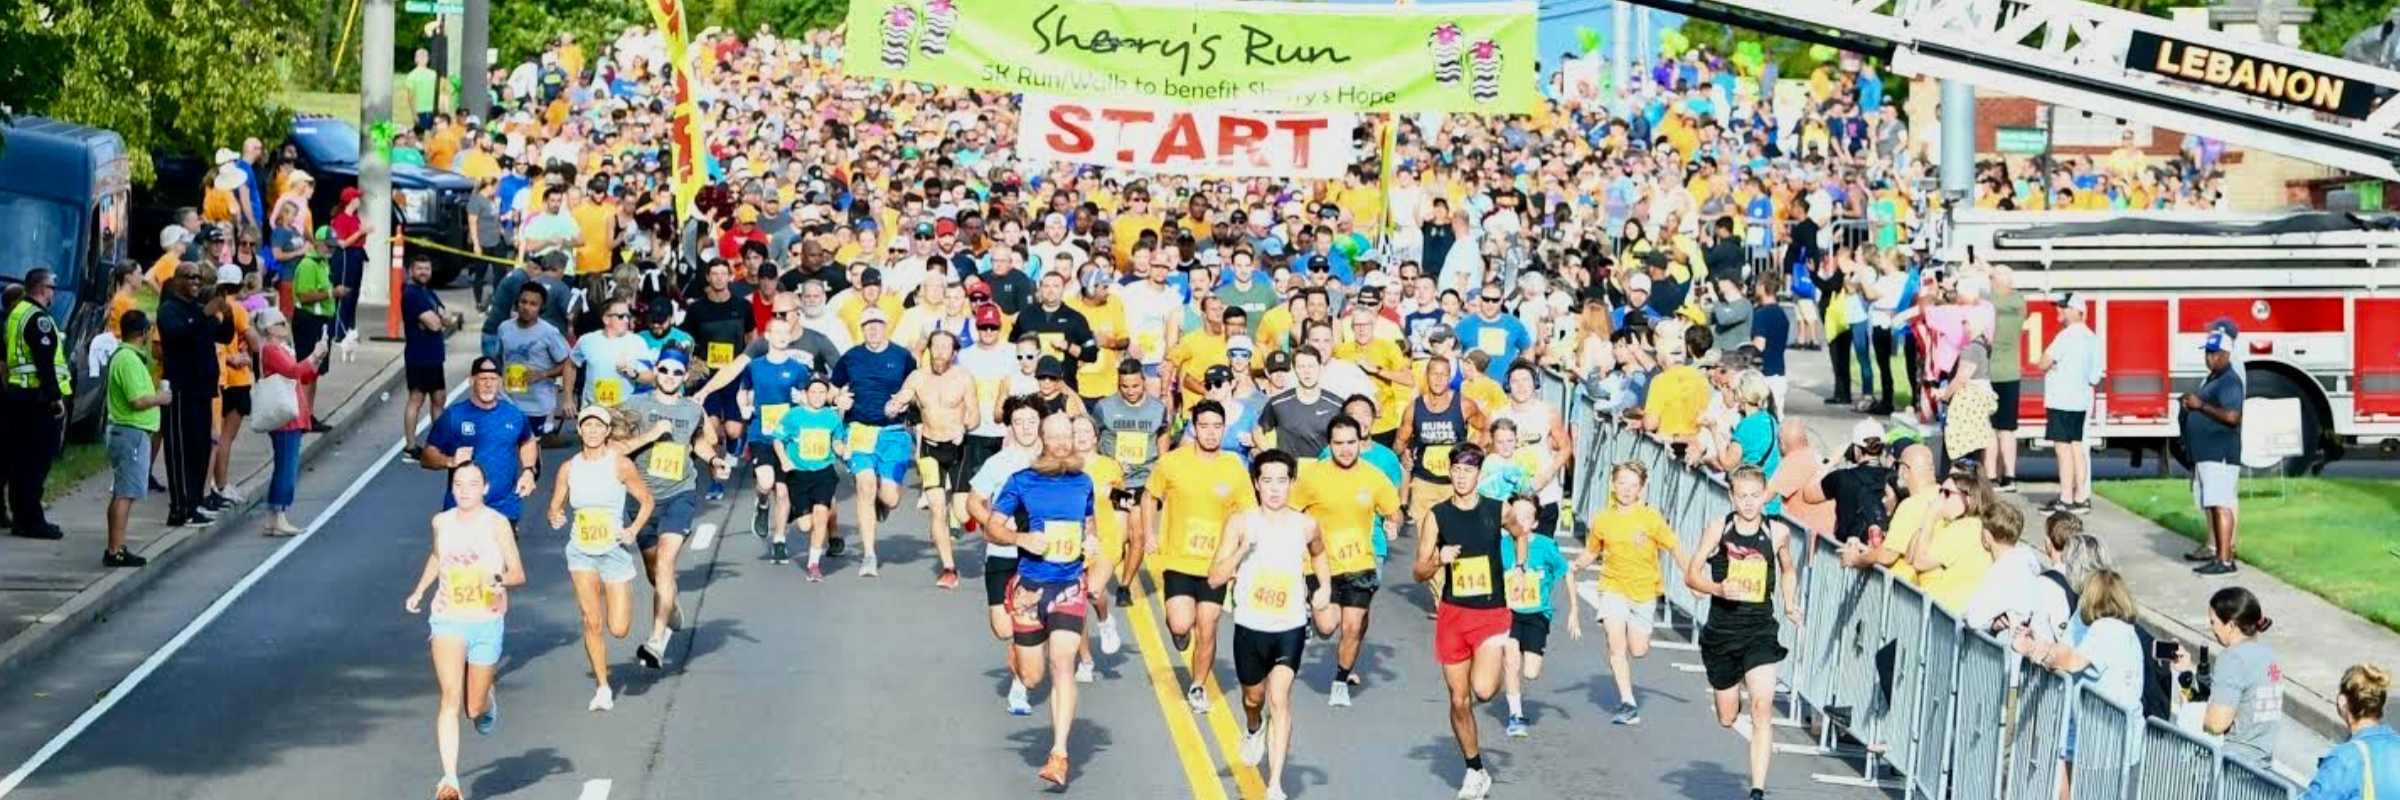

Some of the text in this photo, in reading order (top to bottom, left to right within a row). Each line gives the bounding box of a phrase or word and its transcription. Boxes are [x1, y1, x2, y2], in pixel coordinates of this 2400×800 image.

[1032, 3, 1351, 76] Sherry's Run
[982, 63, 1010, 81] 5K
[1135, 76, 1157, 95] to
[1164, 79, 1239, 99] benefit
[1249, 81, 1330, 106] Shry's
[1337, 84, 1396, 107] Hope
[2156, 40, 2344, 110] LEBANON
[1045, 104, 1329, 168] START
[1113, 419, 1136, 429] CEDAR
[580, 525, 608, 542] 520
[1456, 572, 1487, 590] 414
[453, 582, 484, 605] 521
[1253, 587, 1288, 608] 489
